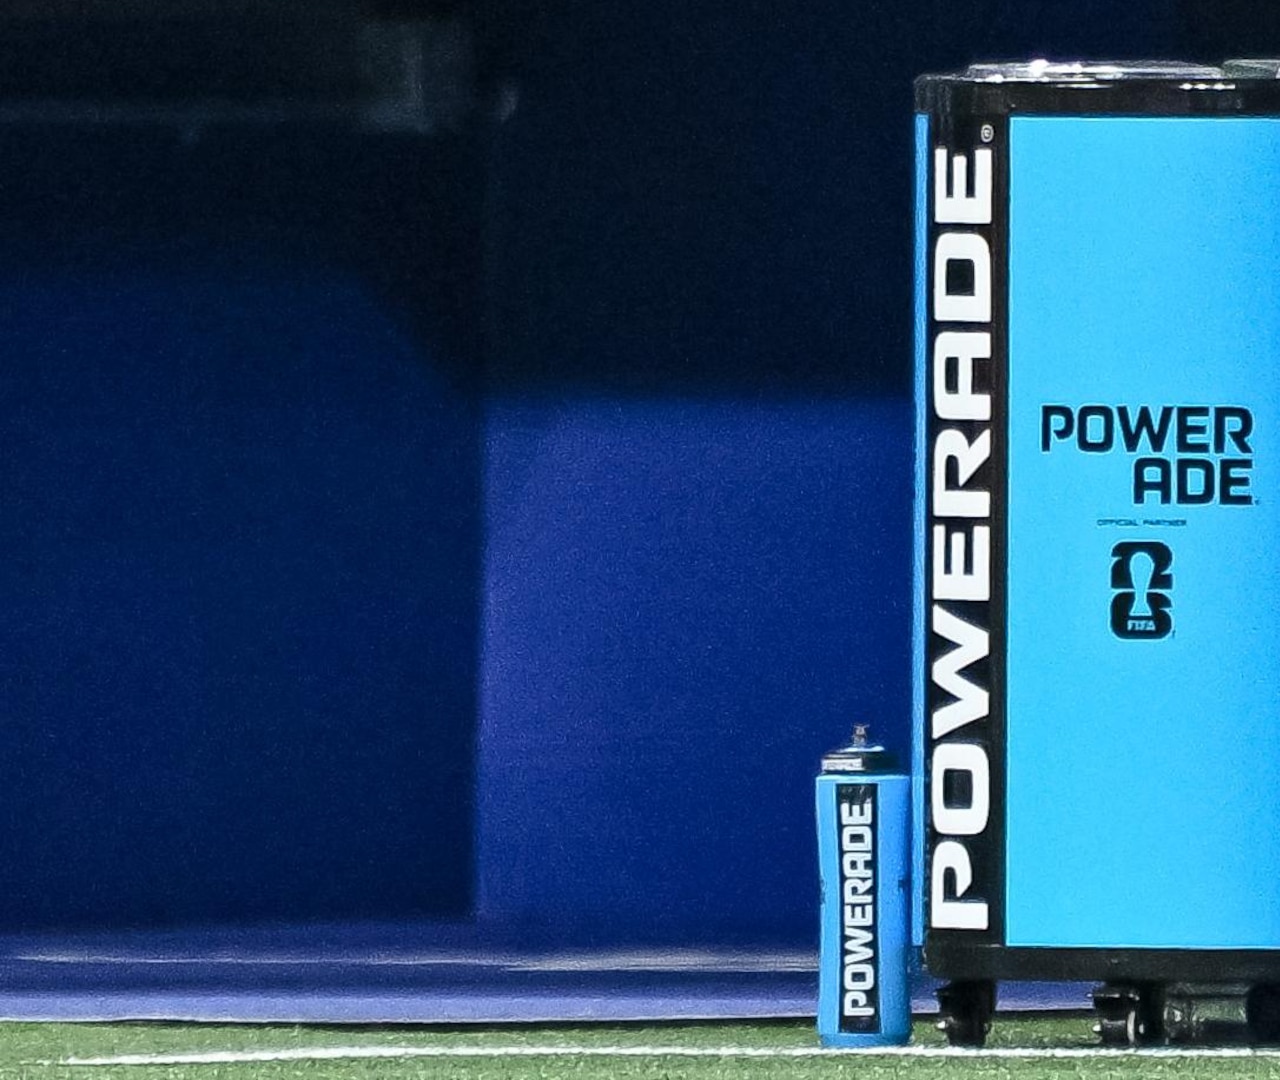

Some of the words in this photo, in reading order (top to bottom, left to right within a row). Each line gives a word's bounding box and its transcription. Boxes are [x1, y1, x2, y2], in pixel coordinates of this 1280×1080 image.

[1041, 405, 1254, 454] POWER
[1133, 457, 1254, 506] ADE
[930, 145, 993, 931] POWERADE
[1127, 619, 1156, 631] FIFA
[839, 801, 875, 1017] POWERADE
